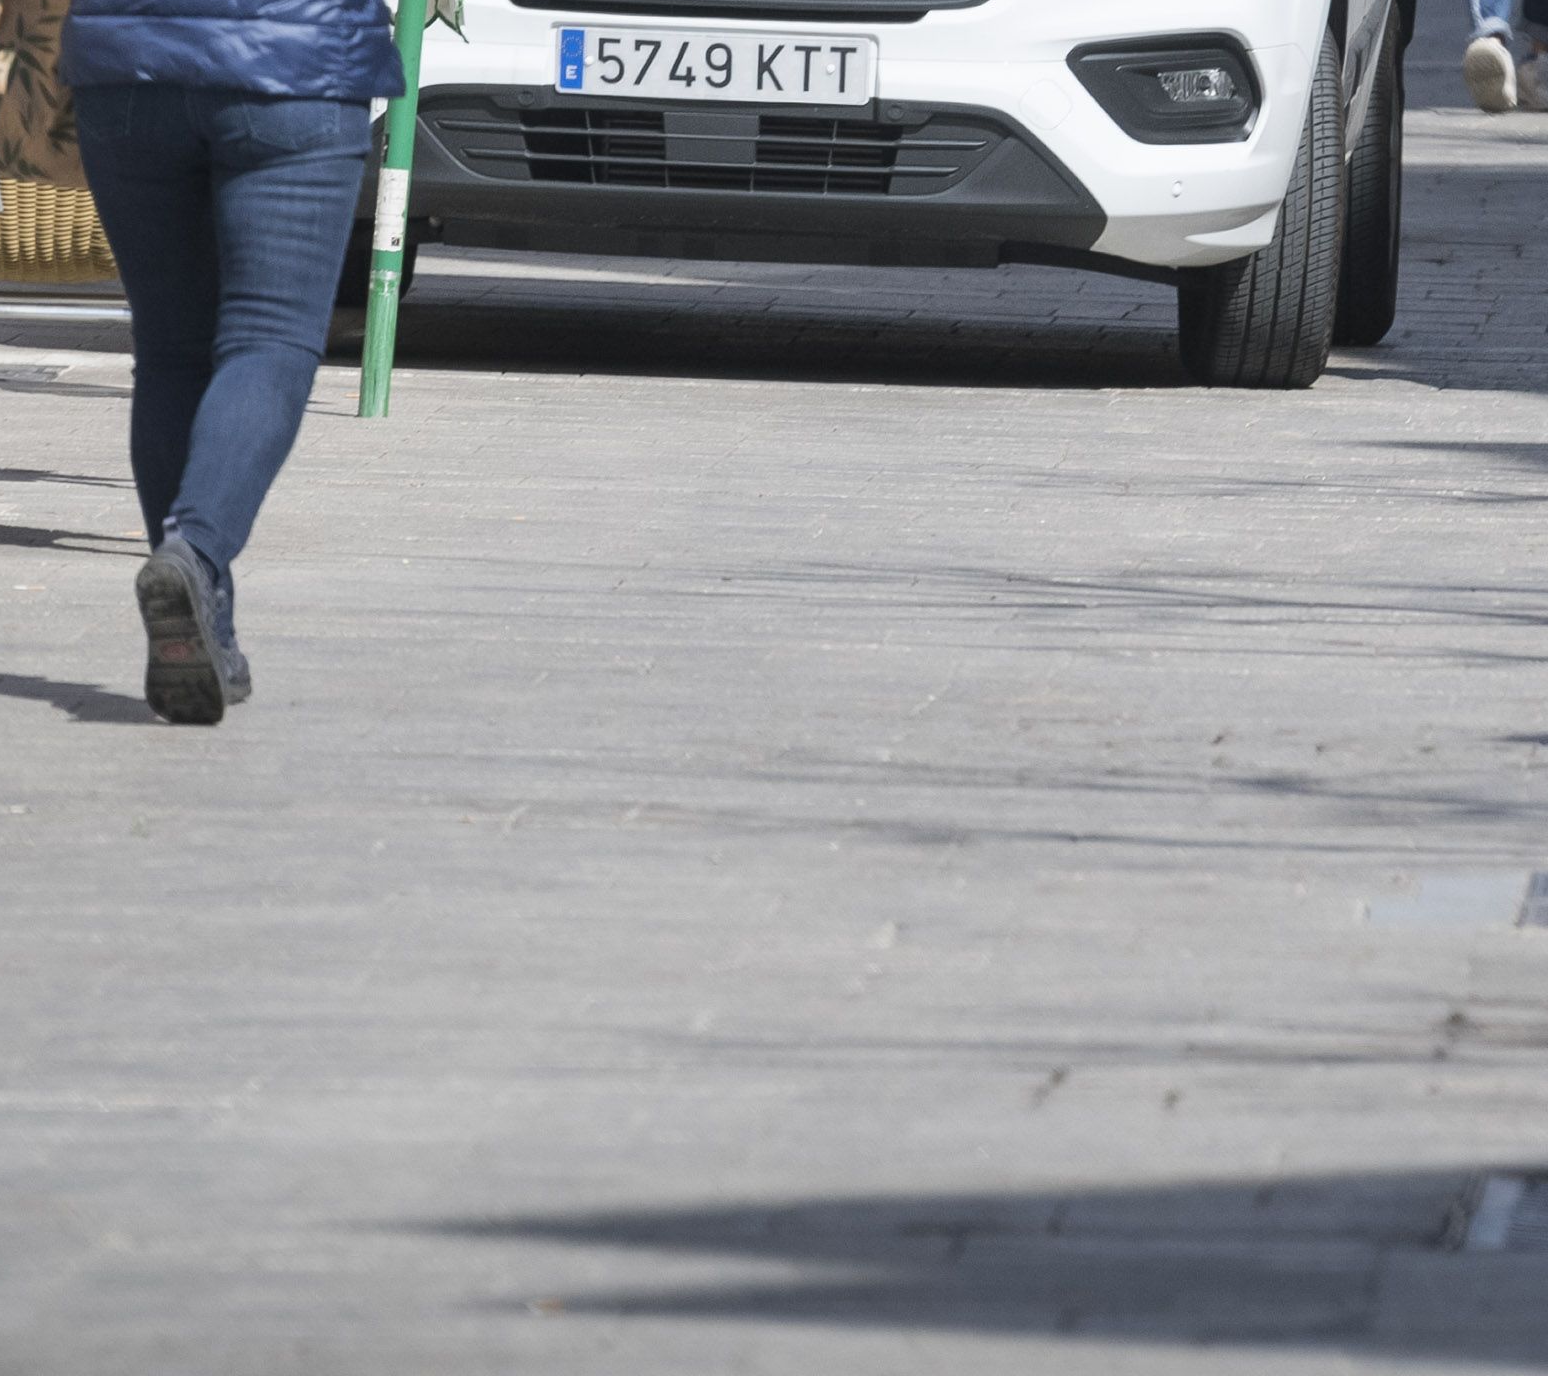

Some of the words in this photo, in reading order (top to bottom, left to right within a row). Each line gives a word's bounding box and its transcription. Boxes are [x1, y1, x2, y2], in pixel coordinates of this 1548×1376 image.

[566, 65, 577, 80] E
[598, 37, 733, 89] 5749
[756, 44, 858, 93] KTT
